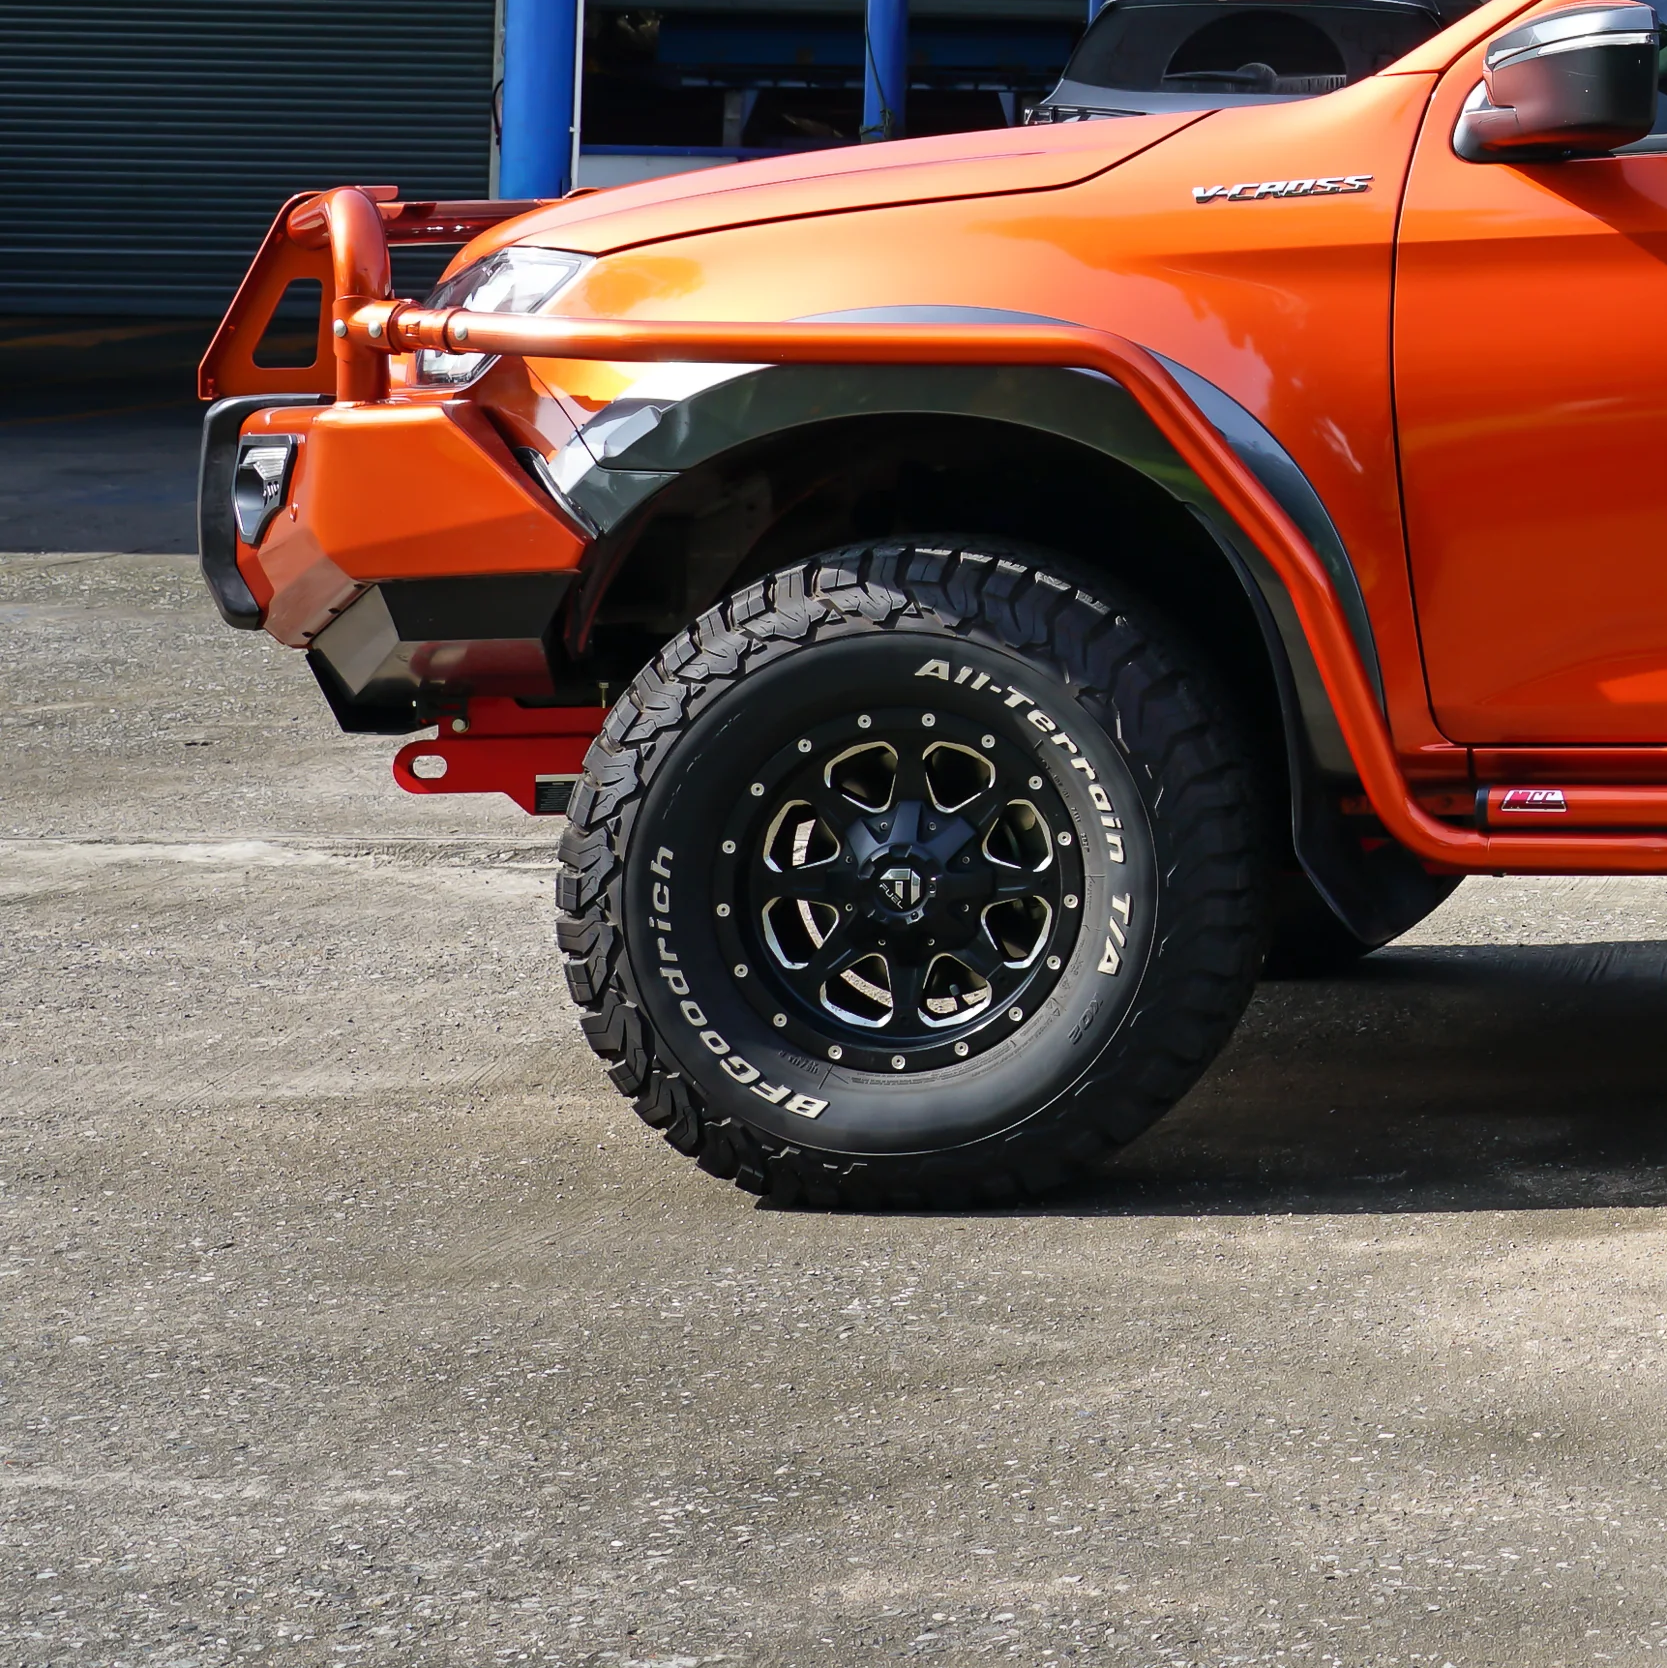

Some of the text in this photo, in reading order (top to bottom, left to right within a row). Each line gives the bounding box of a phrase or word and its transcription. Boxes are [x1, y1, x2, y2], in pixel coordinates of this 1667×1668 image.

[1191, 174, 1374, 204] V-CROSS
[914, 657, 1126, 864] All-Terrain
[1095, 893, 1135, 977] T/A
[878, 882, 904, 910] FUEL
[646, 844, 831, 1120] BFGoodrich
